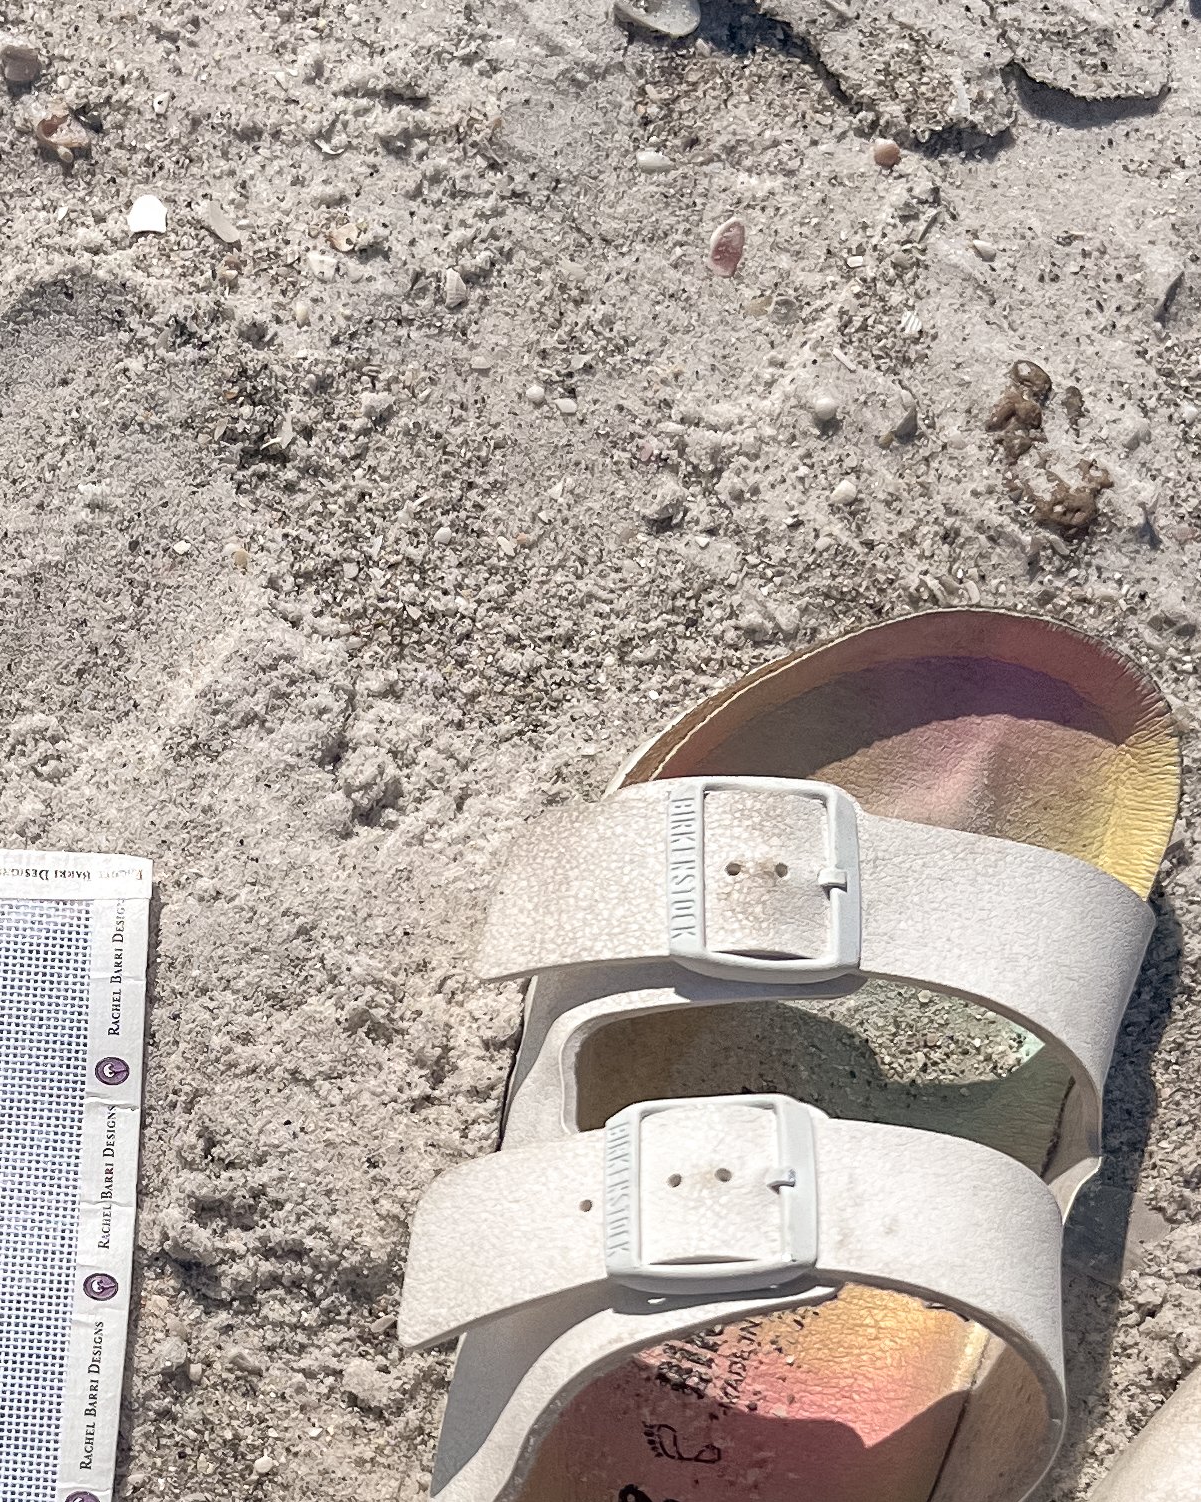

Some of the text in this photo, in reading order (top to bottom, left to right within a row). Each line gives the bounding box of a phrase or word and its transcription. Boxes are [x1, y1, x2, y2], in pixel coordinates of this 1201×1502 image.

[109, 948, 124, 984] BARRI
[107, 989, 122, 1036] RACHEL
[102, 1105, 117, 1158] DESIGNS
[100, 1162, 114, 1200] BARRI
[79, 1321, 104, 1470] RACHEL BARRI DESIGNS
